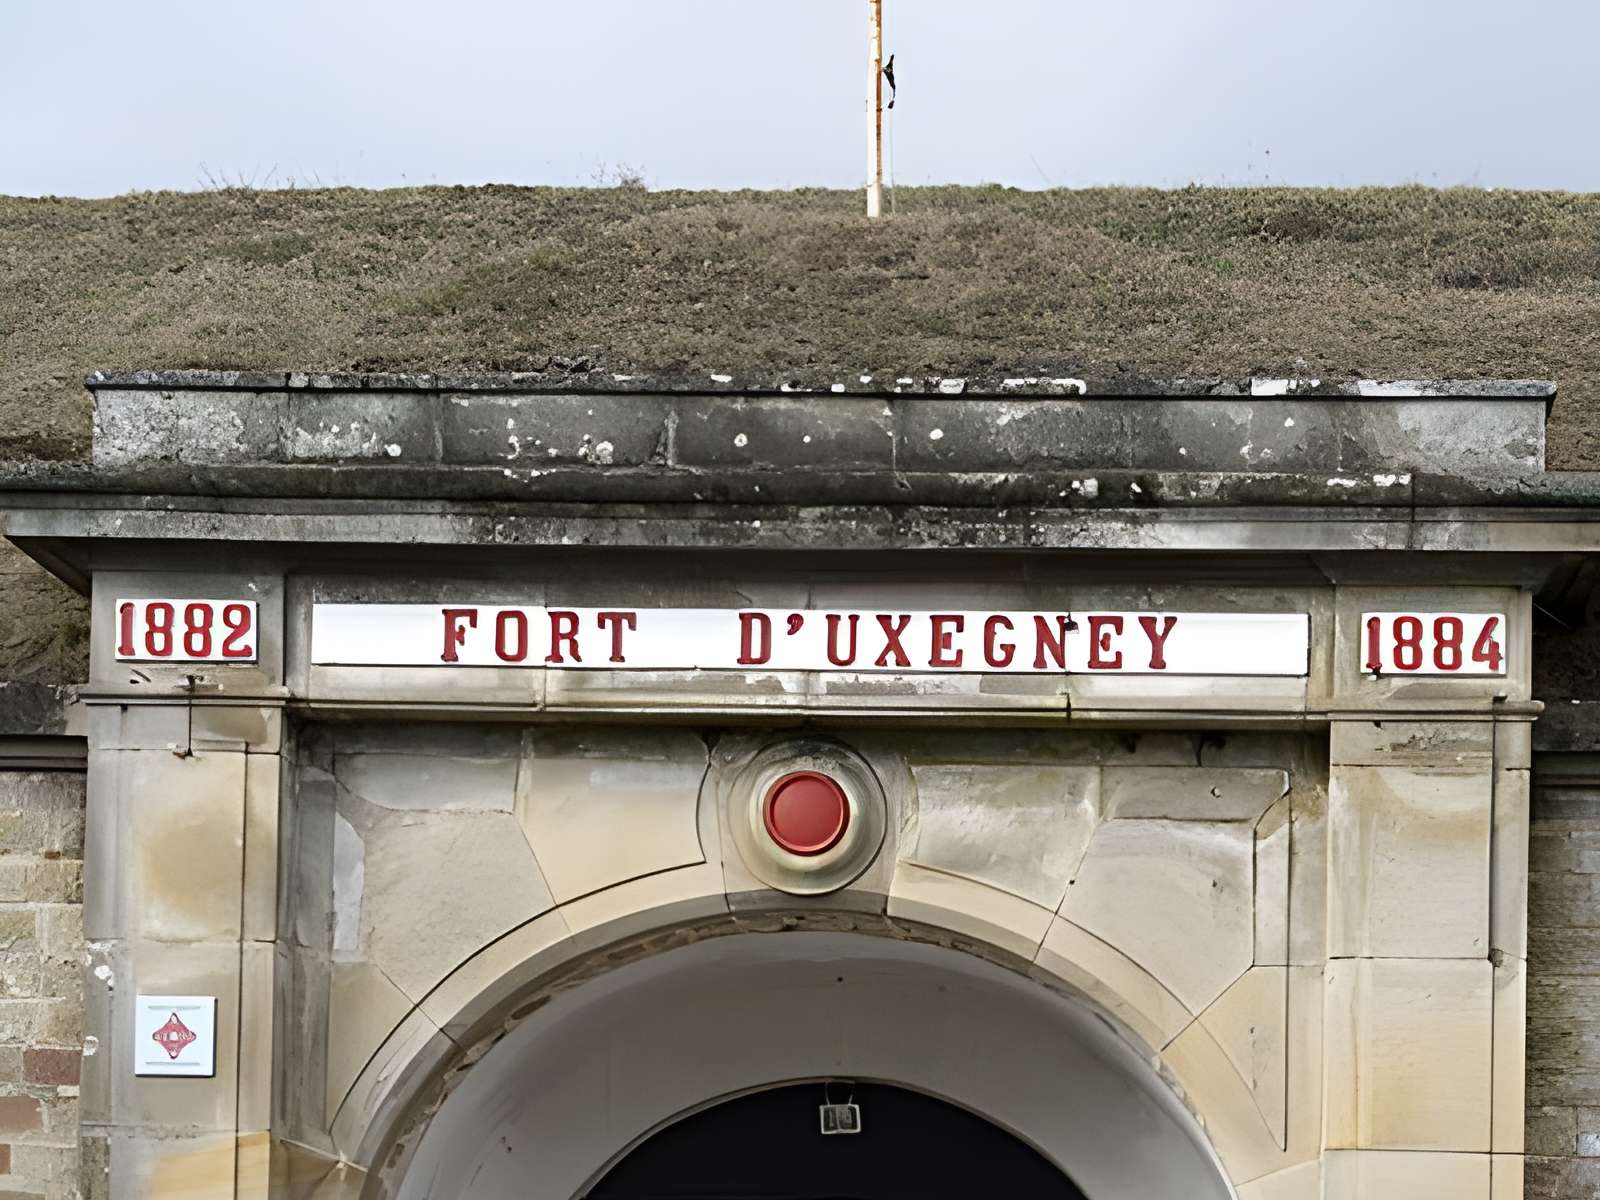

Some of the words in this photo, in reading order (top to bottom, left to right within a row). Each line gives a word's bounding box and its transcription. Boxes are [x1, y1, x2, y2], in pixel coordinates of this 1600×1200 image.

[118, 602, 252, 658] 1882
[442, 608, 636, 663] FORT
[737, 612, 1176, 670] D'UXEGNEY
[1366, 615, 1501, 671] 1884
